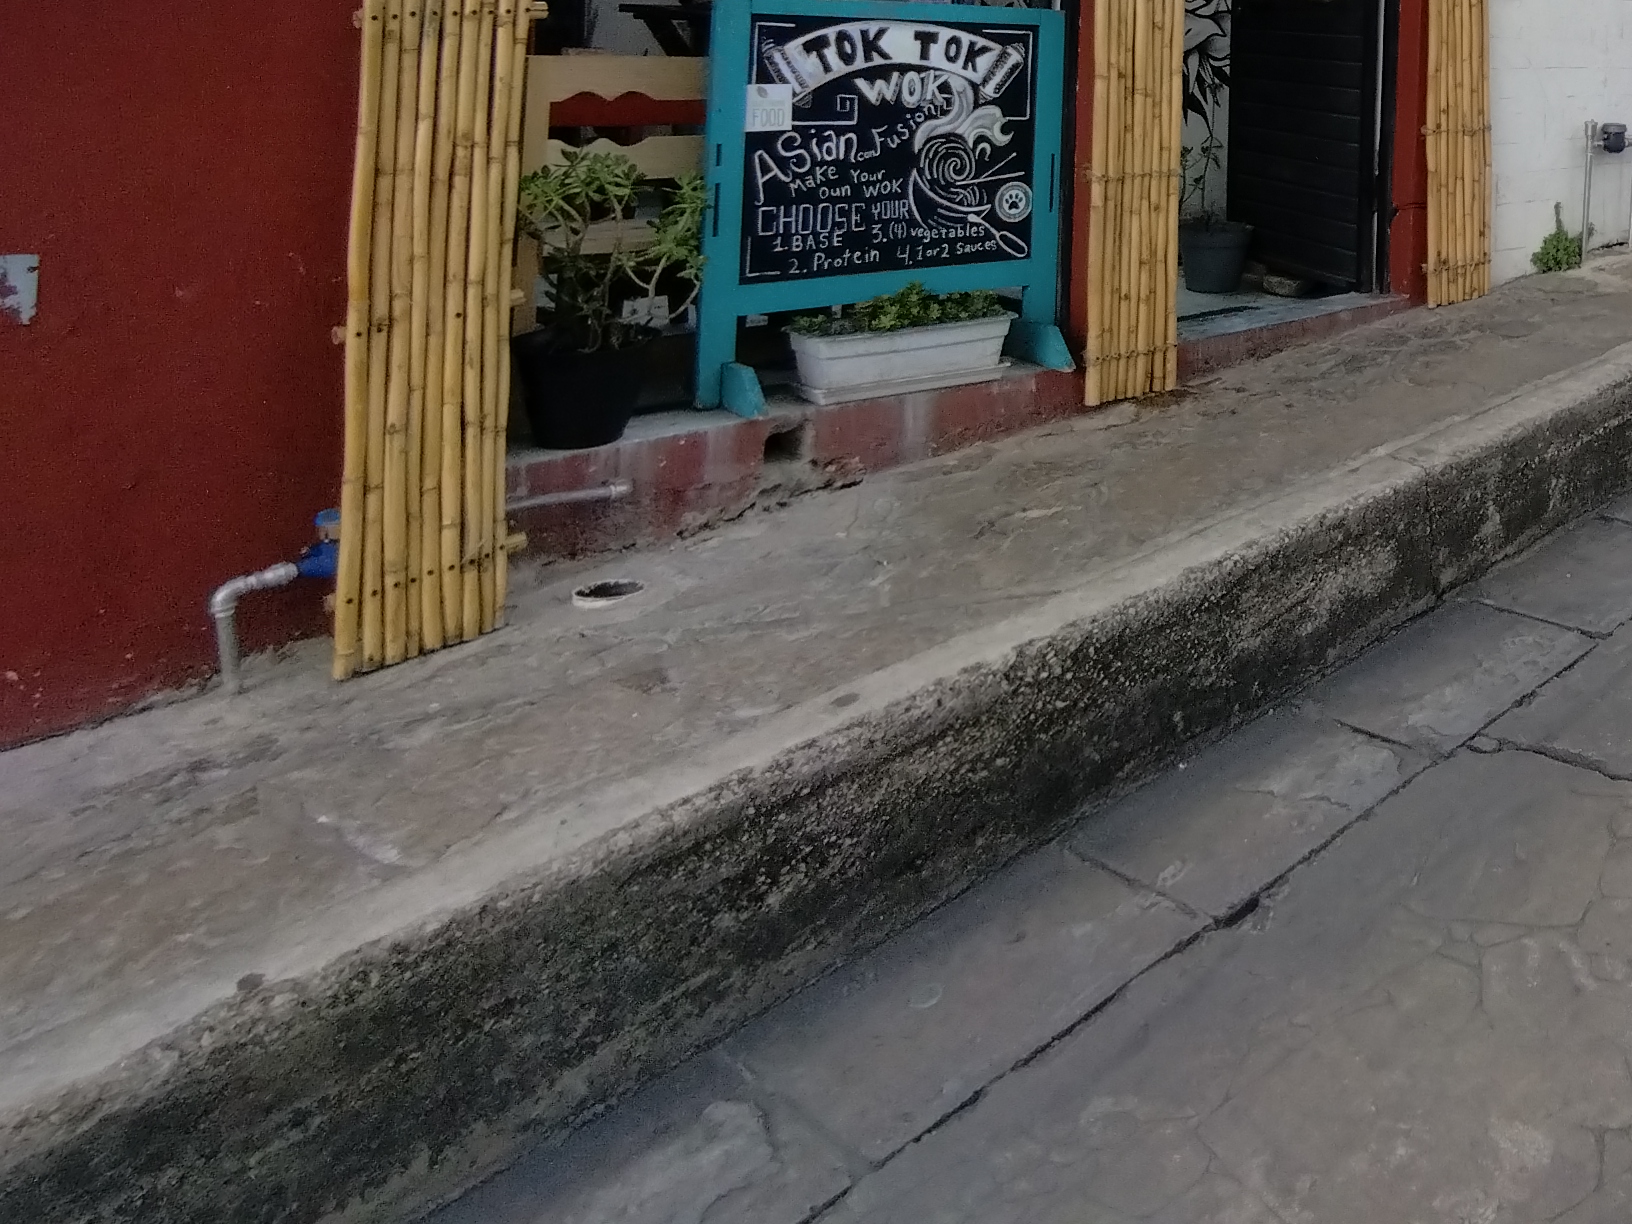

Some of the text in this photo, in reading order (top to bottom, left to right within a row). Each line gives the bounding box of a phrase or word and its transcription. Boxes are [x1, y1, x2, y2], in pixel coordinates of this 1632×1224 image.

[800, 26, 994, 75] TOK TOK
[854, 70, 950, 108] WOK
[752, 108, 785, 127] FOOD
[757, 199, 909, 236] CHOOSE YOUR
[910, 224, 985, 242] vegetables
[813, 246, 880, 271] Protein
